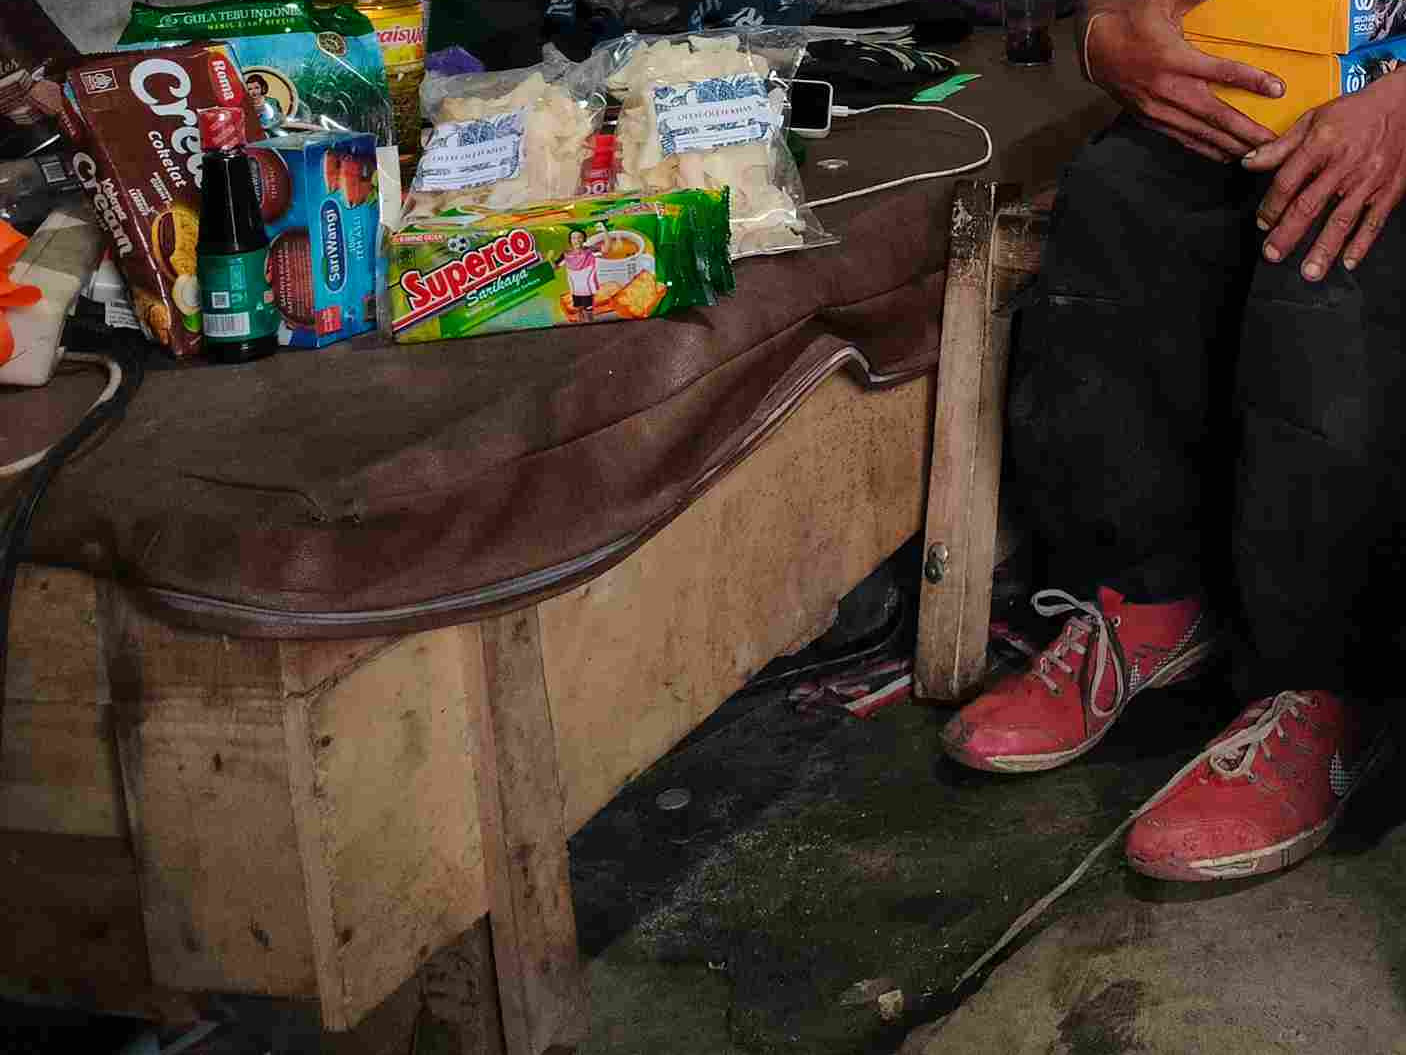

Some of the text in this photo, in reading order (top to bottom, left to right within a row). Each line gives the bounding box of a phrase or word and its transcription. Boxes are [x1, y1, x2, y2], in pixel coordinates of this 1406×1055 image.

[183, 10, 217, 26] GULA
[217, 8, 249, 23] TEBU
[211, 59, 234, 101] Roma
[148, 131, 187, 188] cokelat
[73, 152, 133, 259] Cream
[328, 208, 341, 283] SariWangi
[402, 229, 535, 310] Superco
[466, 268, 529, 307] Sarikaya
